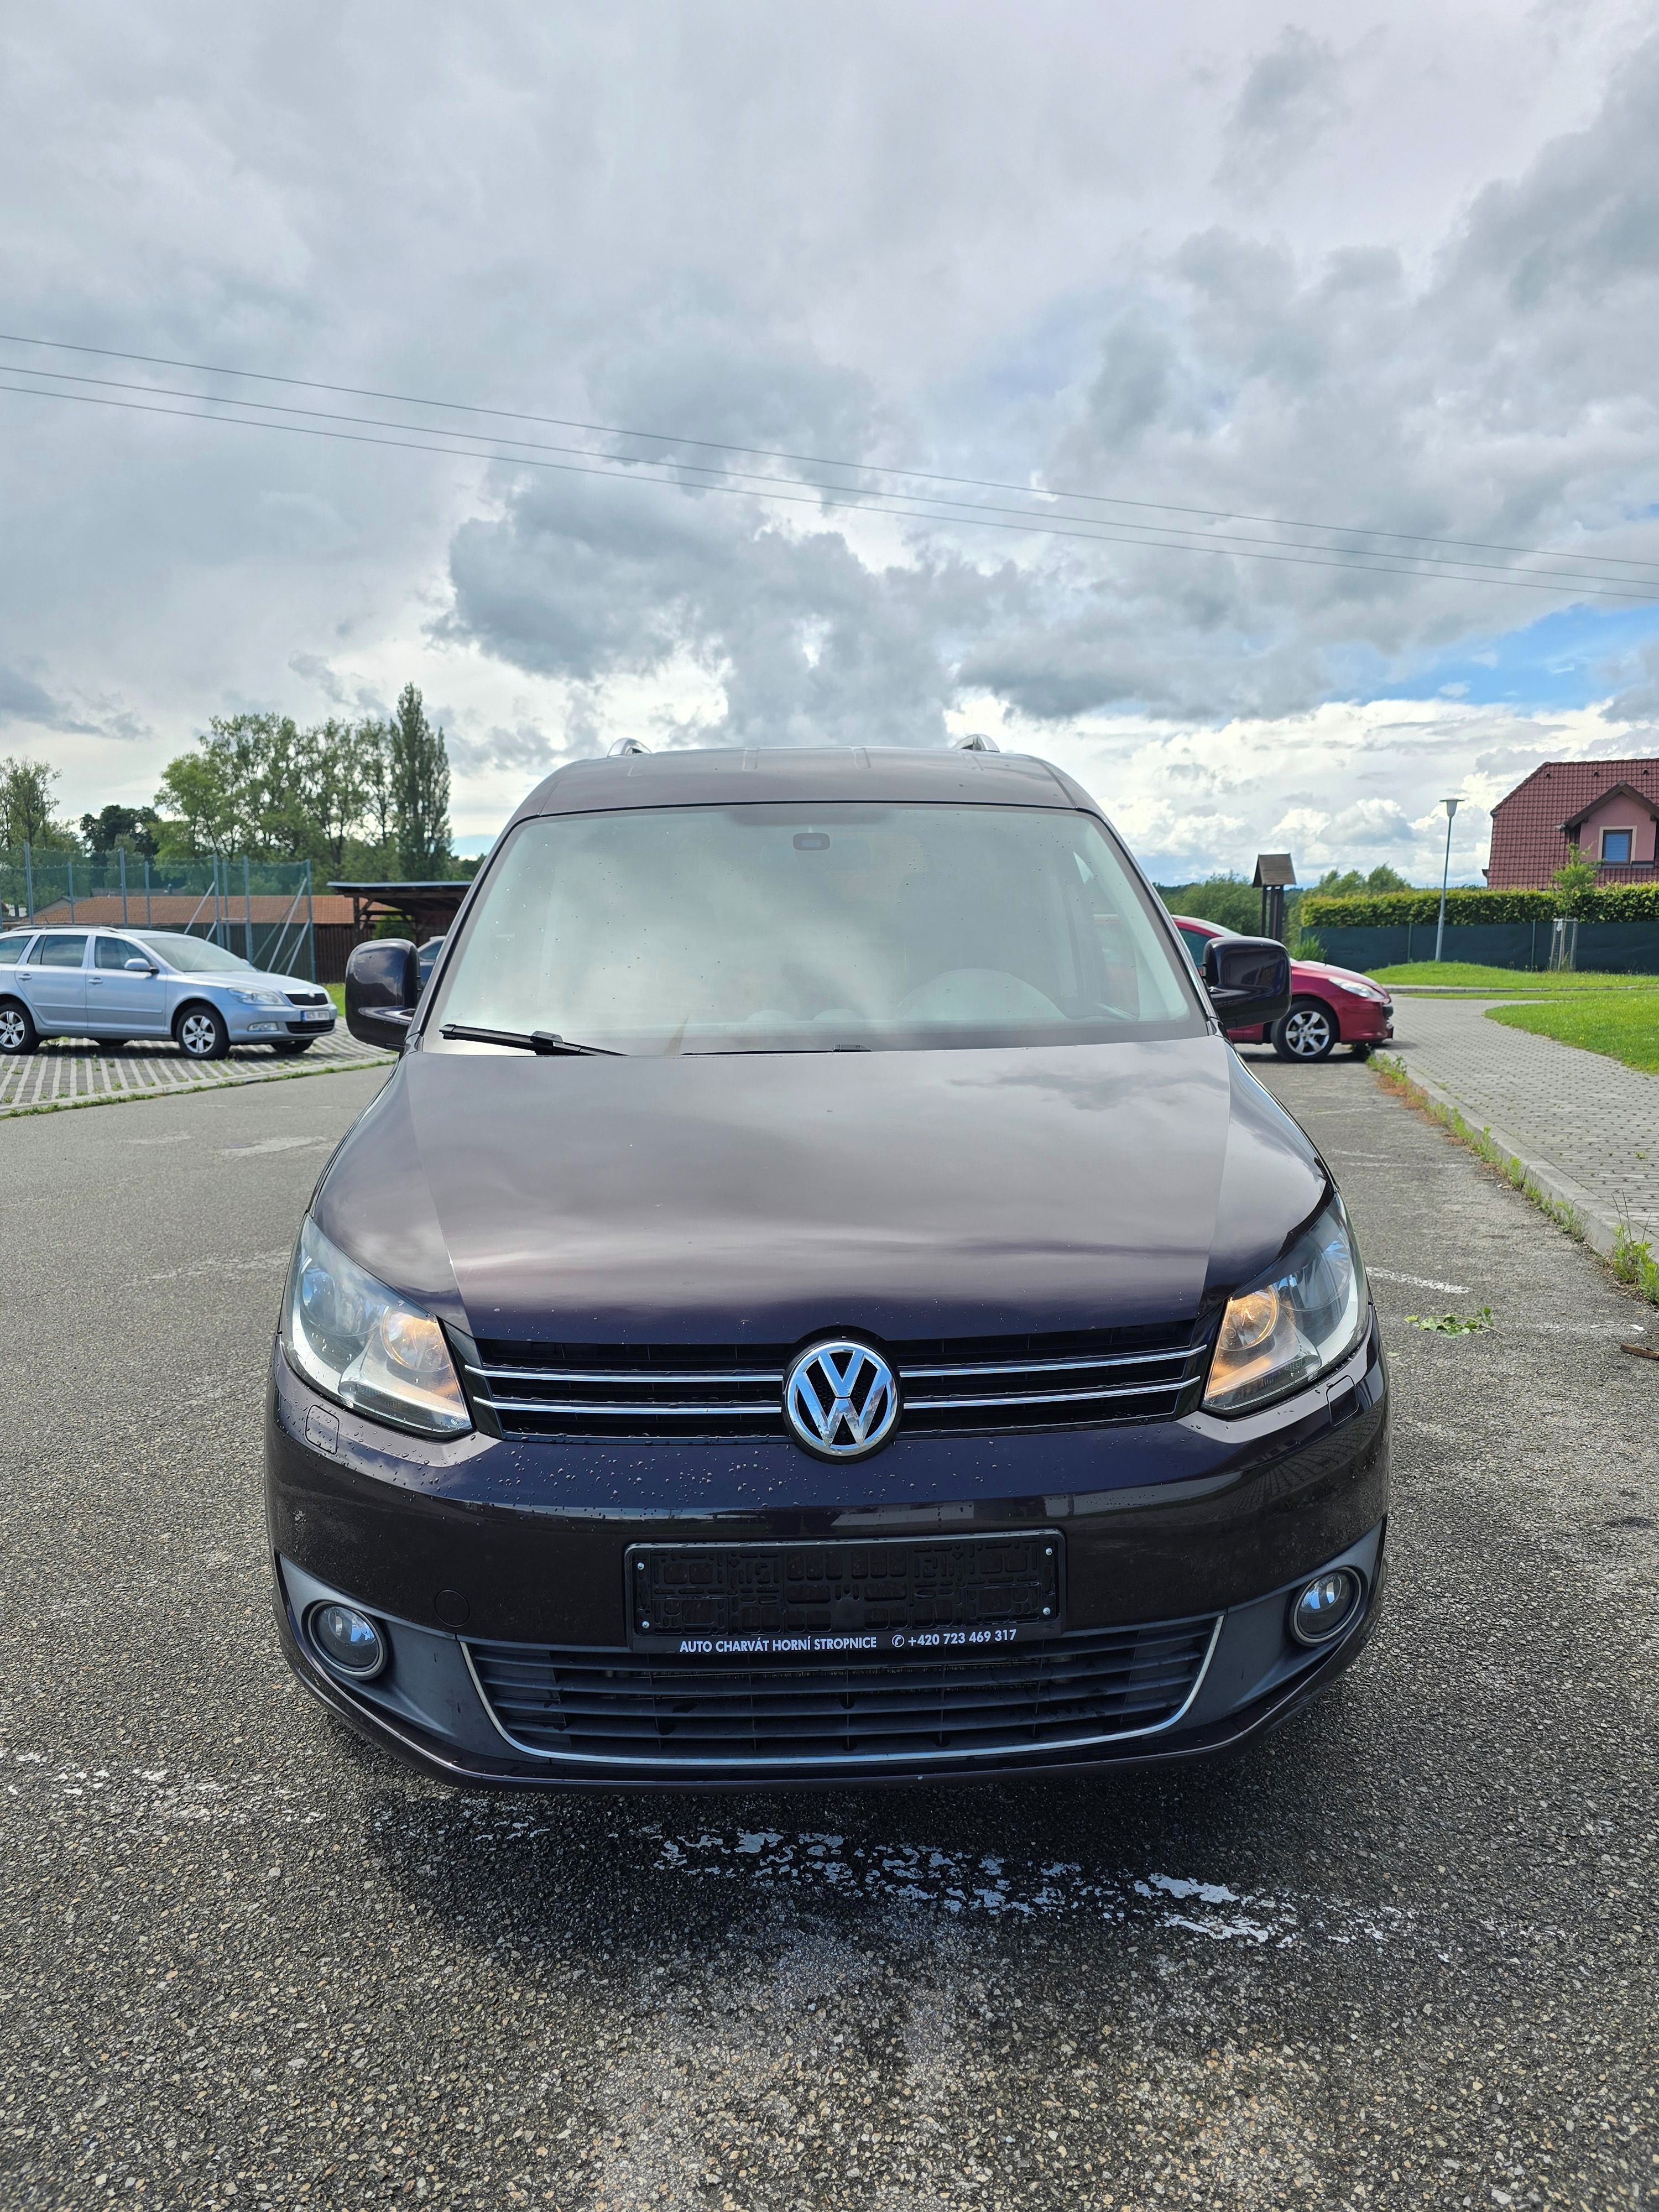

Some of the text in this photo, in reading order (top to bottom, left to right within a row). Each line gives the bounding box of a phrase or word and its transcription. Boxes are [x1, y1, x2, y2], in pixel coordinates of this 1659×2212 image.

[790, 1344, 896, 1450] VW
[679, 1629, 1017, 1652] AUTO CHARVÁT HORNÍ STROPNICE +420 723 469 317
